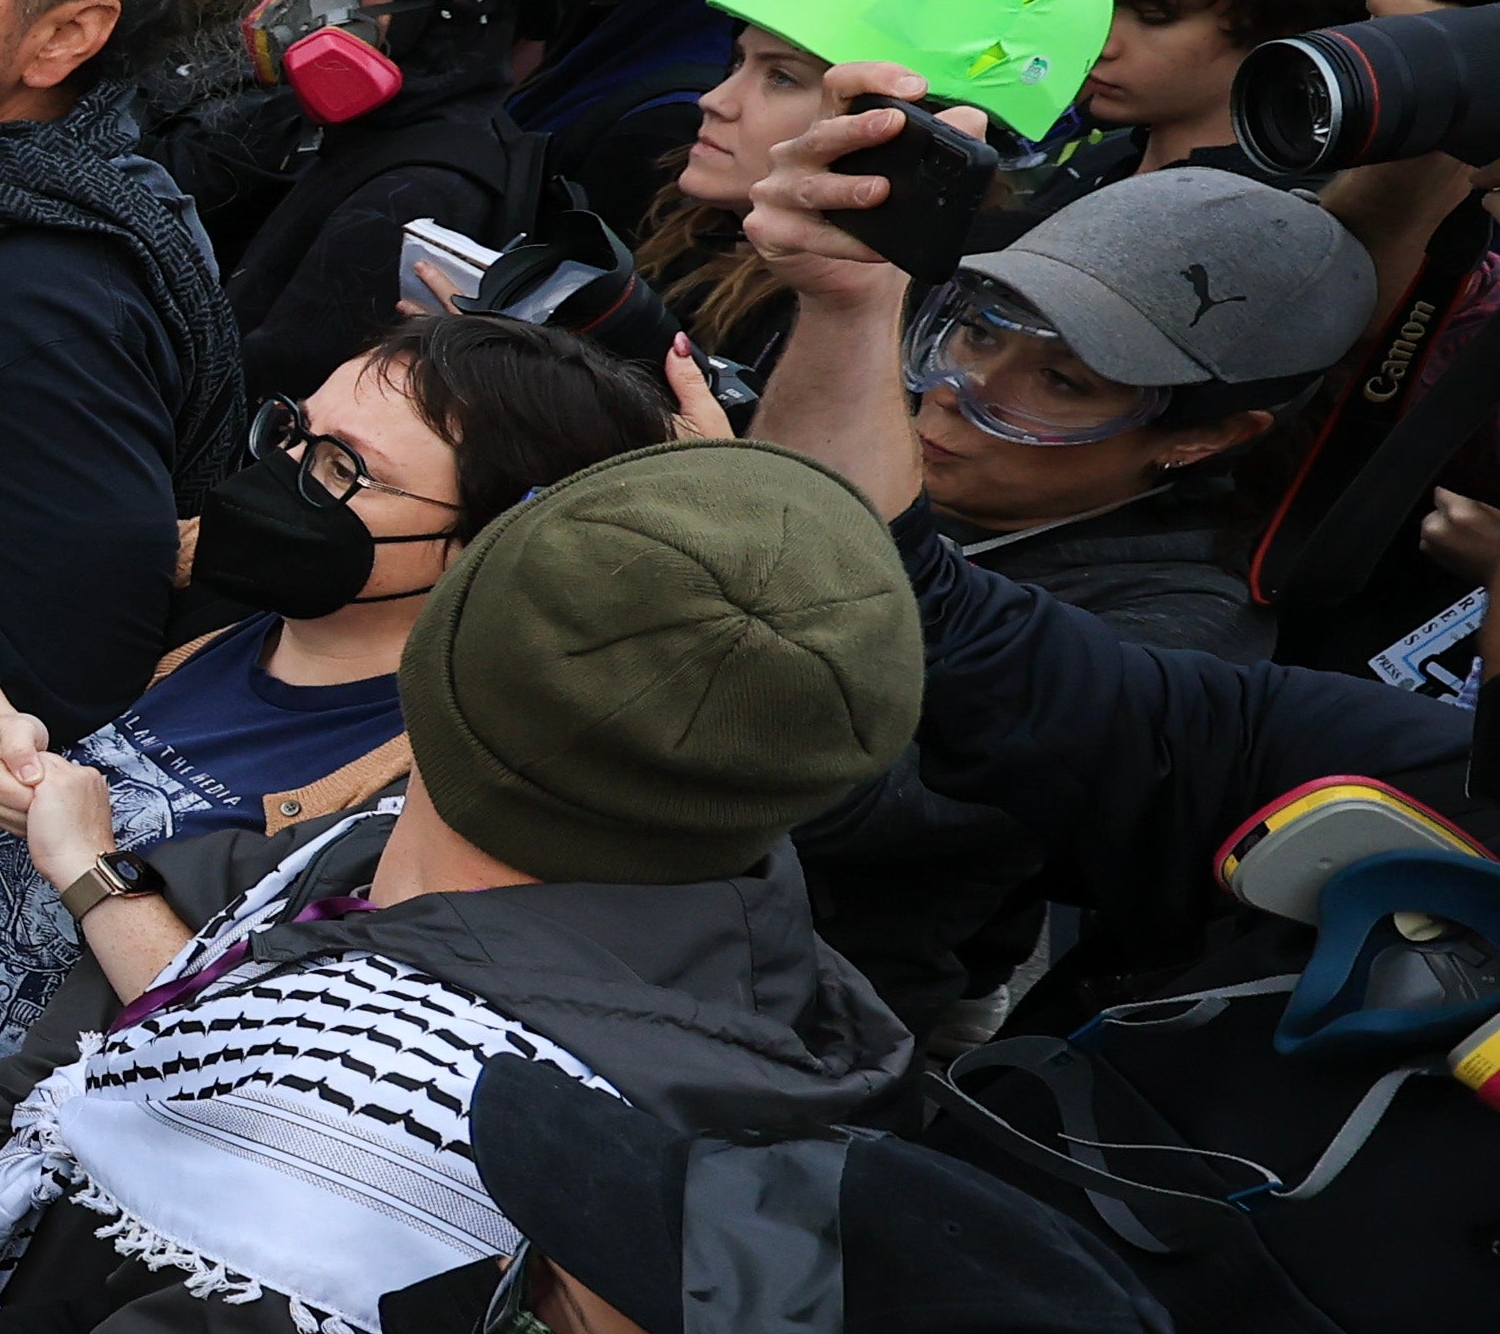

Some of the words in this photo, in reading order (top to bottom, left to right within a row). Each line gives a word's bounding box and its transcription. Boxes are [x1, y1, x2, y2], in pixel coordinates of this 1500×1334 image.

[1364, 300, 1436, 403] Canon
[160, 745, 195, 775] THE
[189, 772, 242, 806] MEDIA
